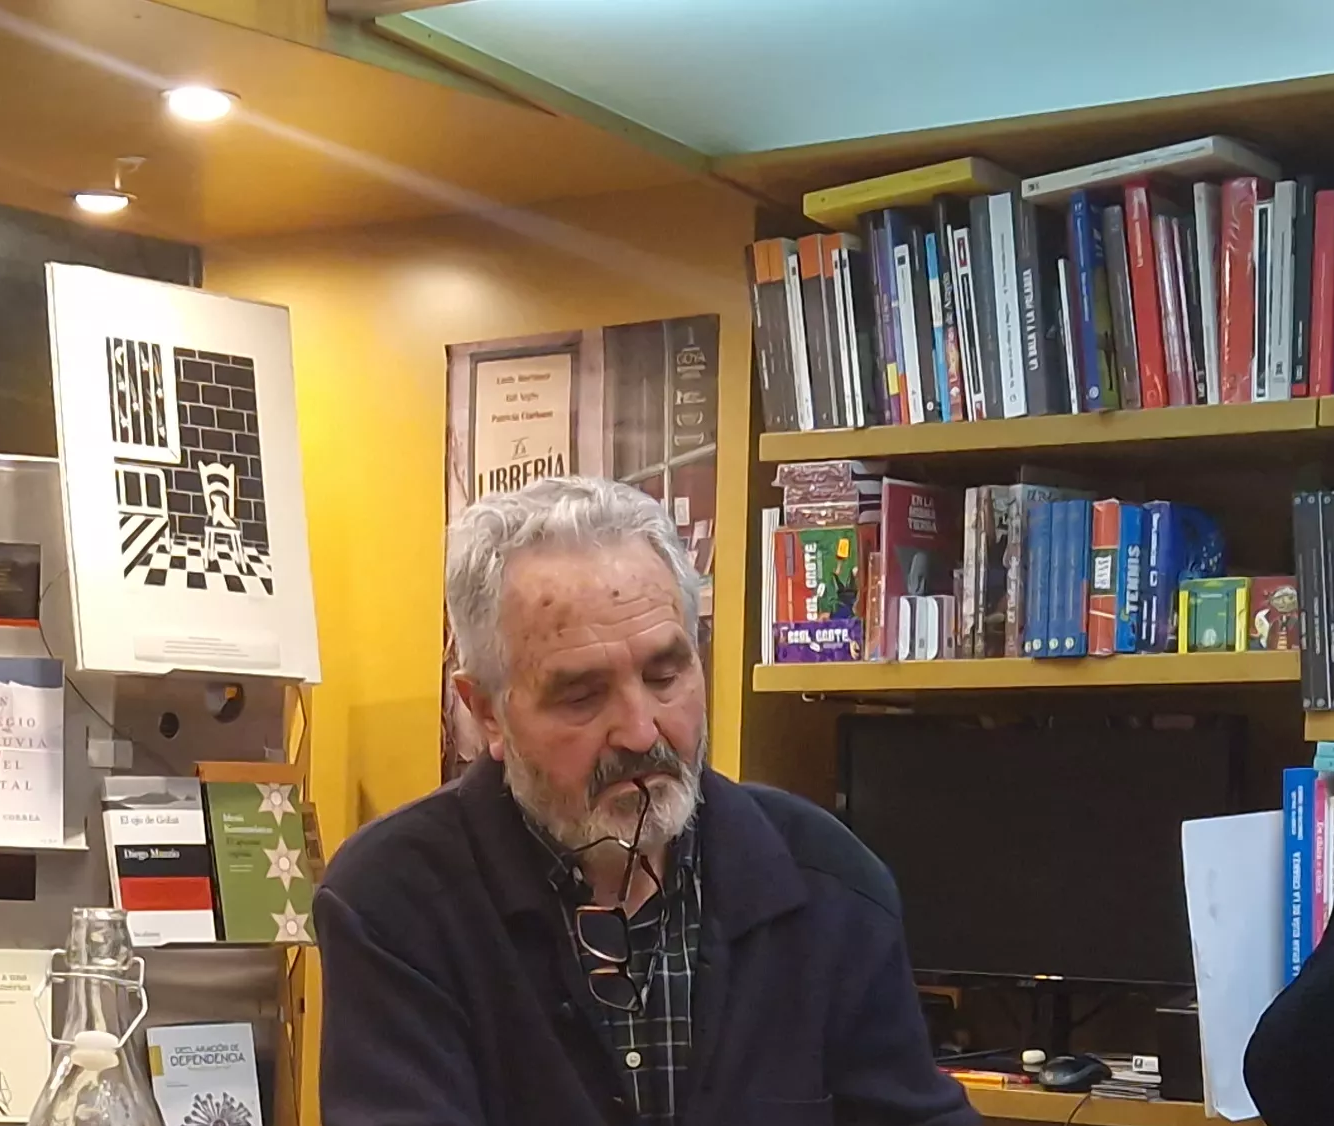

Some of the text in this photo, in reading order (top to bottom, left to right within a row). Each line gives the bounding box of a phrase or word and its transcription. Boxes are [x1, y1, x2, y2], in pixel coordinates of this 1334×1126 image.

[675, 350, 707, 366] GOYA
[3, 758, 25, 771] EL
[120, 815, 129, 825] El
[145, 814, 154, 825] de
[123, 848, 148, 861] Diego
[1292, 891, 1301, 902] LA
[169, 1052, 247, 1068] DEPENDENCIA
